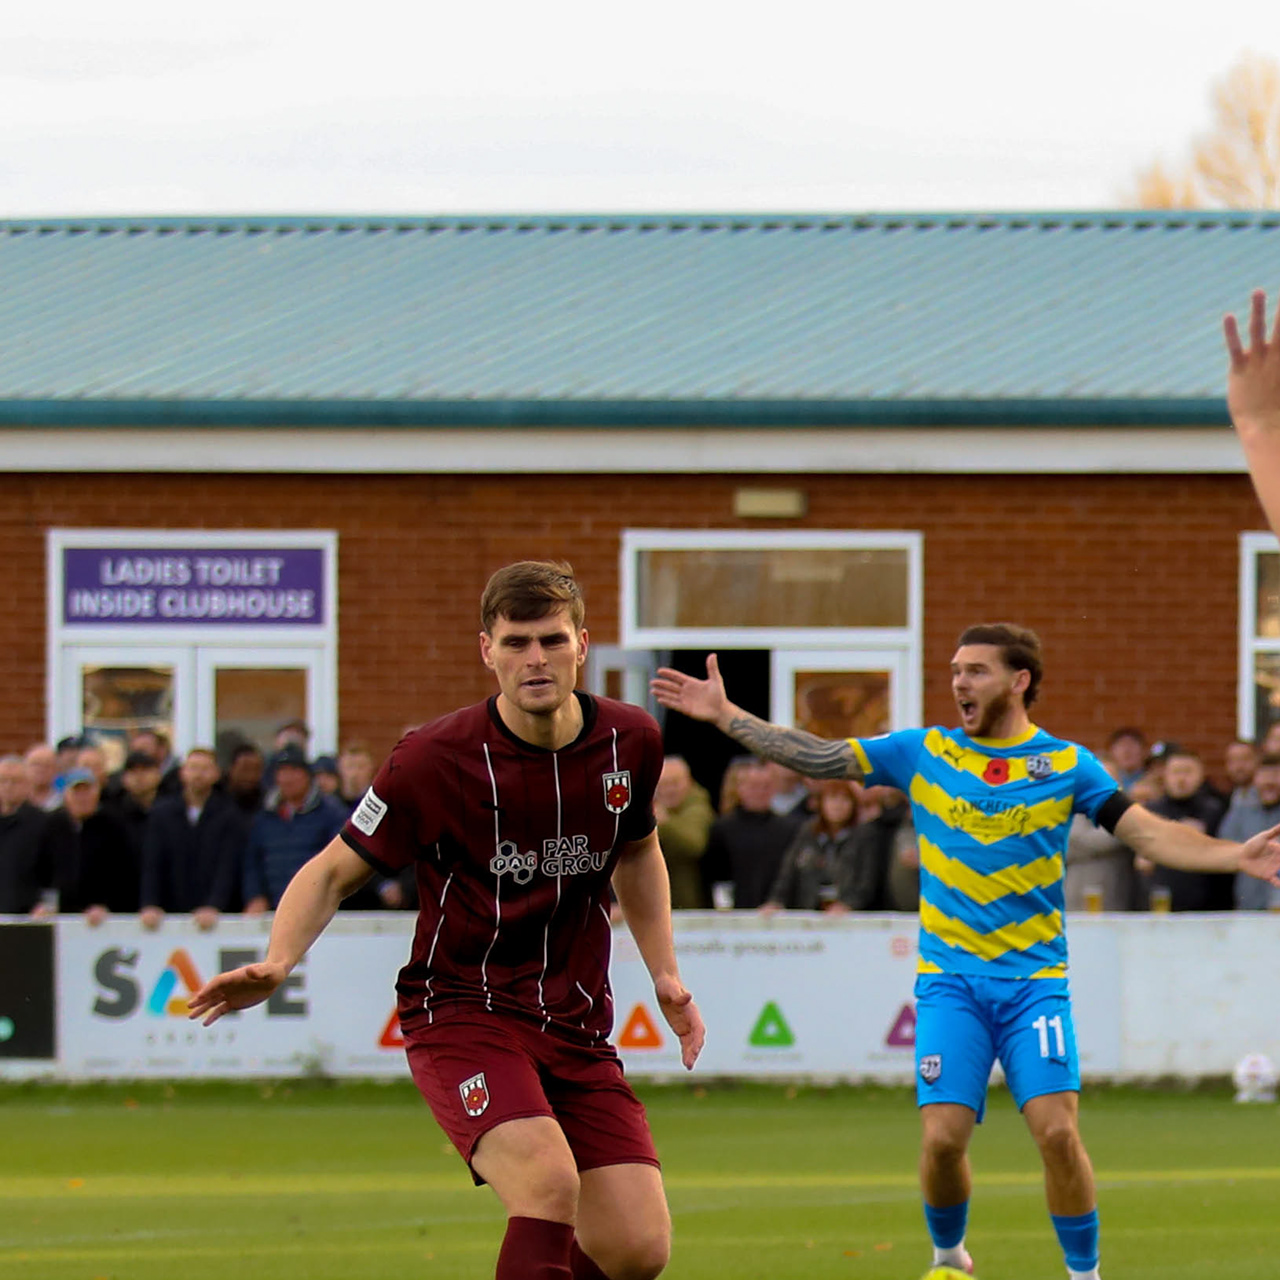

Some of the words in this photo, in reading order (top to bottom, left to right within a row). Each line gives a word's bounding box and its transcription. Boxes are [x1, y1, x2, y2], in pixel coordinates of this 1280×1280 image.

[101, 557, 192, 586] LADIES
[195, 557, 284, 586] TOILET
[69, 589, 156, 618] INSIDE
[158, 589, 315, 618] CLUBHOUSE
[543, 835, 589, 858] PAR
[541, 850, 609, 877] GROU
[1032, 1015, 1066, 1058] 11
